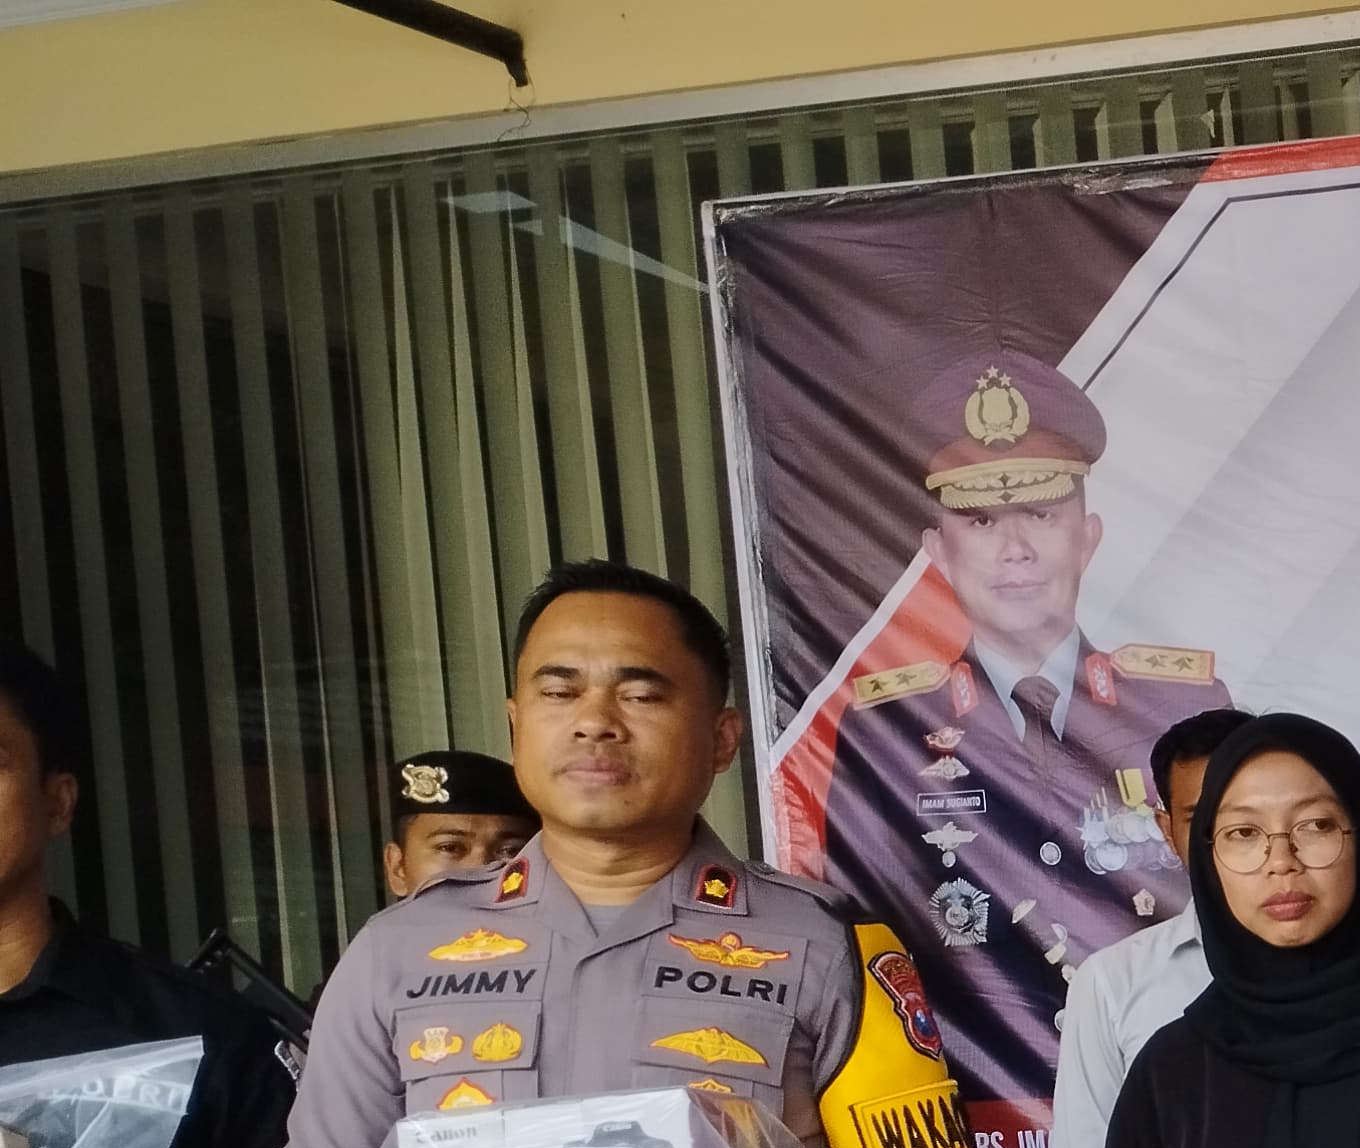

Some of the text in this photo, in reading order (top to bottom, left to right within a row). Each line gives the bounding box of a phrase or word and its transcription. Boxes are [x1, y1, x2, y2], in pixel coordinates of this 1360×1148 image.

[922, 796, 981, 809] IMAM SUGIANTO
[406, 968, 537, 999] JIMMY
[654, 966, 788, 1006] POLRI
